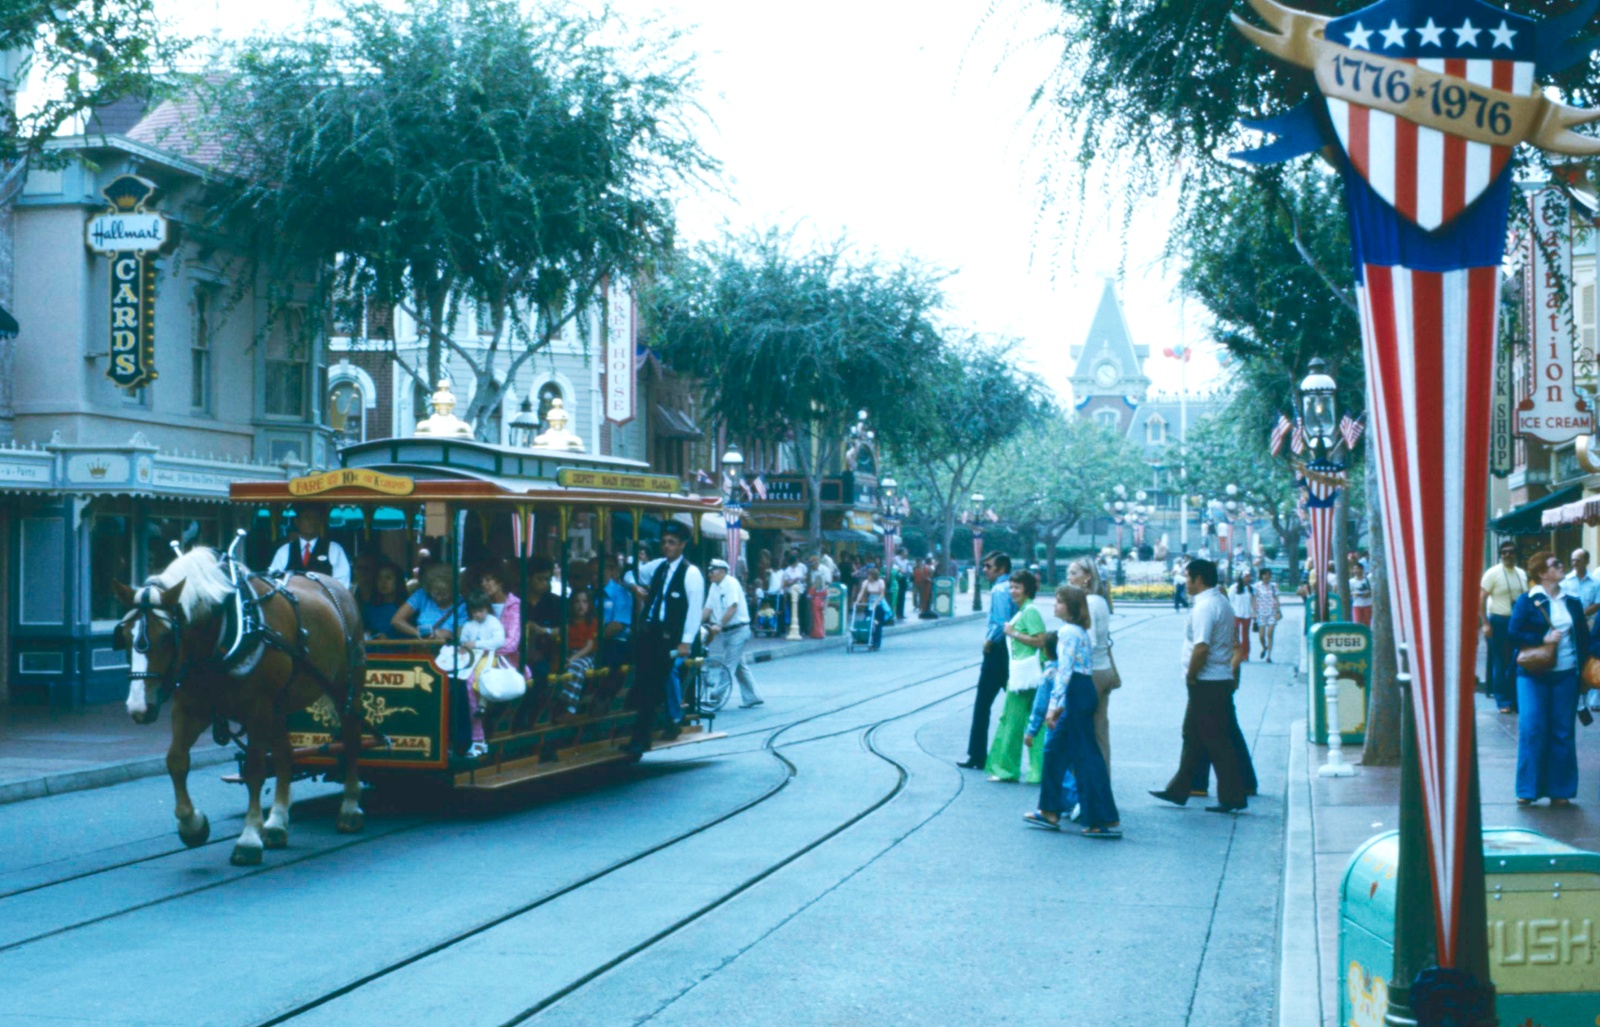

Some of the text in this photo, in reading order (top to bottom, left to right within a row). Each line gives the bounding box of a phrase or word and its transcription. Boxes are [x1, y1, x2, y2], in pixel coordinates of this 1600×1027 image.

[1333, 53, 1512, 136] 1776 1976
[92, 219, 162, 246] Hallmark
[113, 259, 138, 375] CARDS
[613, 348, 626, 411] HOUSE
[1496, 404, 1507, 465] SHOP
[1520, 417, 1590, 429] ICE CREAM
[296, 478, 324, 493] FARE
[1326, 637, 1362, 648] PUSH
